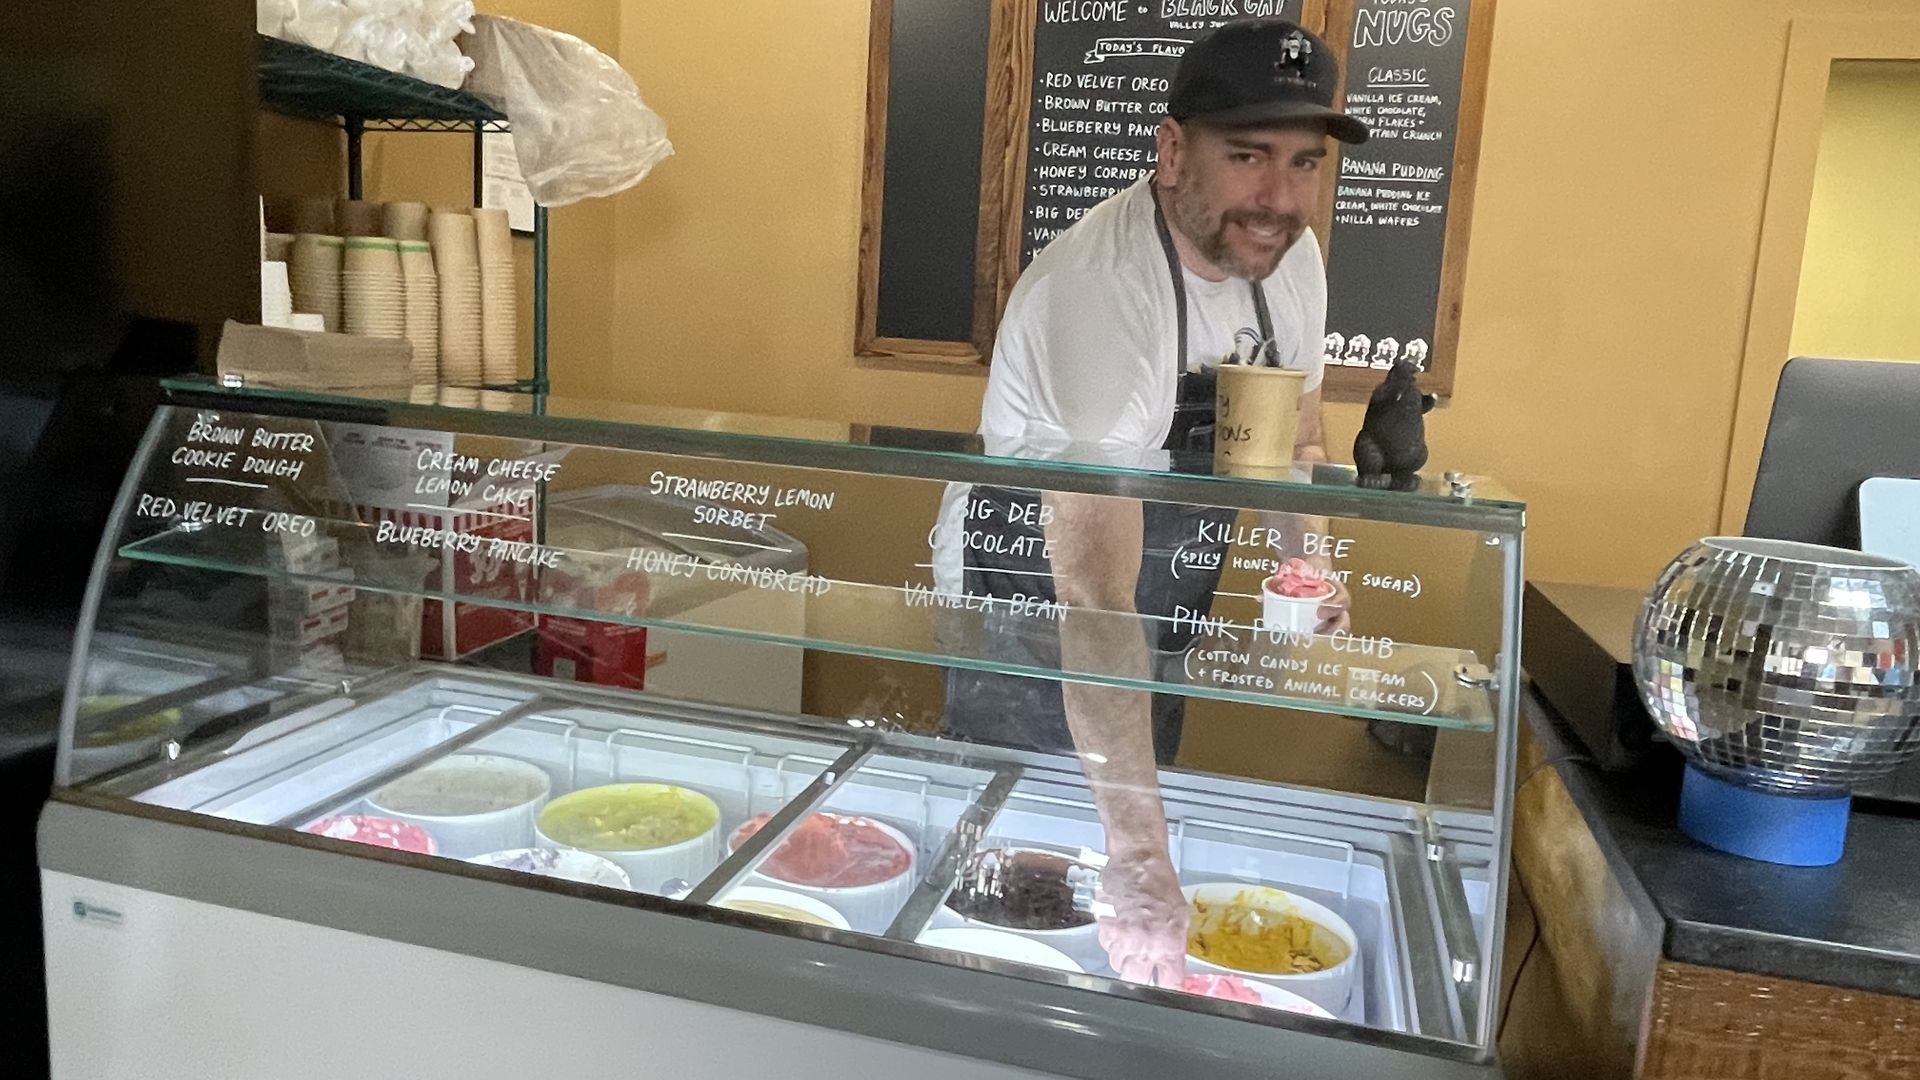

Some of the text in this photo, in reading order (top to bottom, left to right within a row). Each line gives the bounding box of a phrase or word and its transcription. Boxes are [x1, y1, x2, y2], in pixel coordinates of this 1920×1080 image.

[1044, 0, 1129, 23] WELCOME
[1161, 0, 1239, 18] BLACK
[1169, 21, 1205, 30] VALLEY
[1354, 7, 1455, 48] NUGS
[1099, 42, 1143, 53] TODAY'S
[1046, 72, 1169, 91] RED VELVET OREO
[1368, 66, 1427, 83] CLASSIC
[1045, 95, 1090, 111] BROWN
[1095, 99, 1143, 114] BUTTER
[1347, 94, 1384, 103] VANILLA
[1388, 94, 1403, 103] ICE
[1345, 107, 1371, 115] WHITE
[1042, 118, 1121, 135] BLUEBERRY
[1378, 117, 1415, 128] FLAKES
[1403, 130, 1442, 141] CRUNCH
[1043, 142, 1087, 159] CREAM
[1093, 146, 1142, 161] CHEESE
[1040, 166, 1087, 179] HONEY
[1341, 156, 1445, 180] BANANA PUDDING
[1337, 185, 1373, 197] BANANA
[1416, 191, 1431, 200] ICE
[1035, 205, 1059, 219] BIG
[1371, 202, 1399, 211] WHITE
[1378, 216, 1420, 226] WAFERS
[188, 421, 244, 445] BROWN
[252, 428, 315, 452] BUTTER
[171, 446, 304, 481] COOKIE DOUGH
[417, 449, 562, 481] CREAM CHEESE
[415, 475, 532, 508] LEMON CAKE
[650, 471, 835, 510] STRAWBERRY LEMON
[137, 493, 316, 537] RED VELVET OREO
[693, 505, 777, 531] SORBET
[1008, 502, 1054, 526] DEB
[377, 520, 565, 568] BLUEBERRY PANCAKE
[1198, 520, 1356, 559] KILLER BEE
[627, 547, 831, 596] HONEY CORNBREAD
[1233, 557, 1279, 574] HONEY
[904, 581, 1069, 622] VANILLA BEAN
[1173, 605, 1239, 641] PINK
[1331, 629, 1393, 659] CLUB
[1260, 655, 1308, 673] CANDY
[1317, 663, 1342, 676] ICE
[1213, 670, 1274, 689] FROSTED
[1284, 678, 1341, 697] ANIMAL
